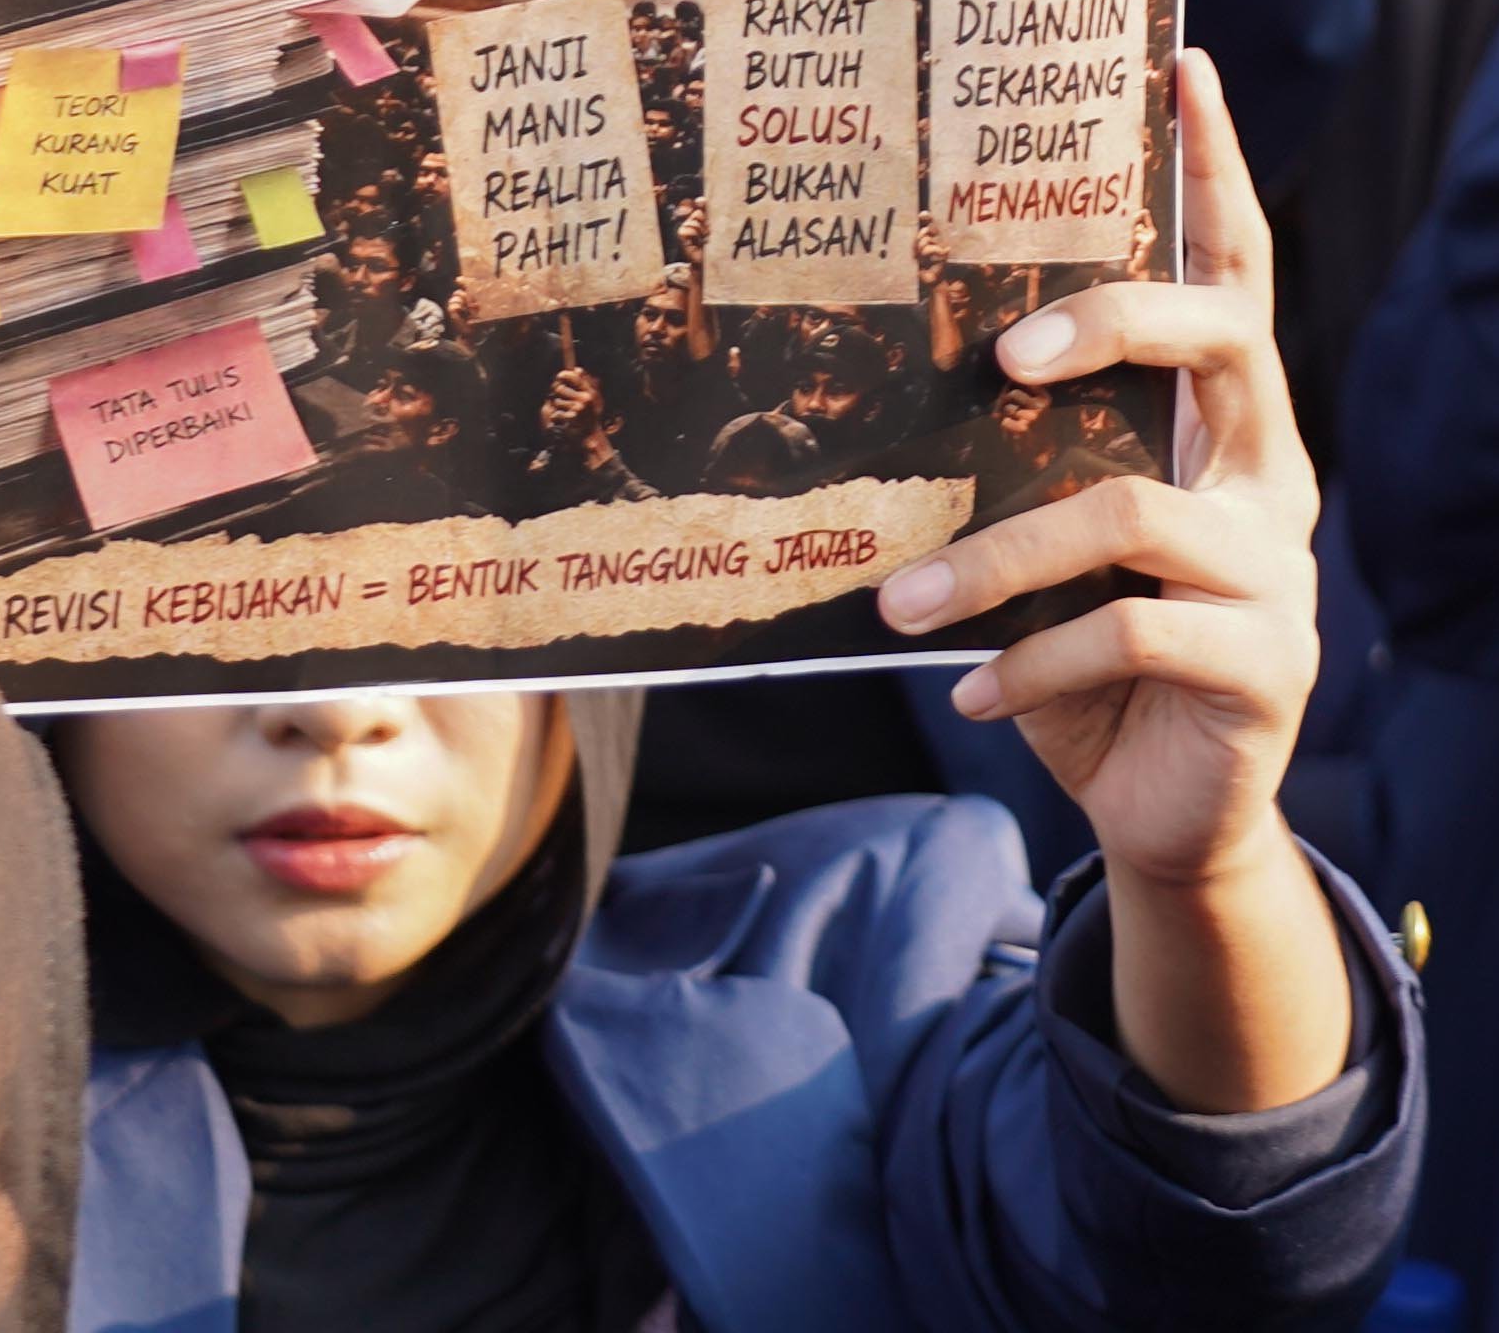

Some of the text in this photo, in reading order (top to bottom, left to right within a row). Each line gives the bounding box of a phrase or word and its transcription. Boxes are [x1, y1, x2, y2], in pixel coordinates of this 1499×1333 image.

[470, 34, 589, 93] JANJI
[744, 50, 864, 93] BUTUH
[952, 58, 1127, 108] SEKARANG
[53, 92, 129, 120] TEORI
[482, 93, 606, 152] MANIS
[736, 104, 883, 152] SOLUSI,
[31, 130, 140, 156] KURANG
[974, 119, 1102, 165] DIBUAT
[37, 170, 122, 197] KUAT
[482, 158, 627, 218] REALITA
[745, 159, 864, 204] BUKAN
[948, 161, 1135, 226] MENANGIS!
[492, 208, 625, 278] PAHIT!
[732, 206, 895, 261] ALASAN!
[90, 363, 241, 424] TATA TULIS
[104, 402, 255, 465] DIPERBAIKI
[3, 589, 122, 639] REVISI
[142, 572, 345, 628] KEBIJAKAN
[406, 555, 539, 603] BENTUK
[556, 538, 748, 593] TANGGUNG
[764, 528, 878, 573] JAWAB
